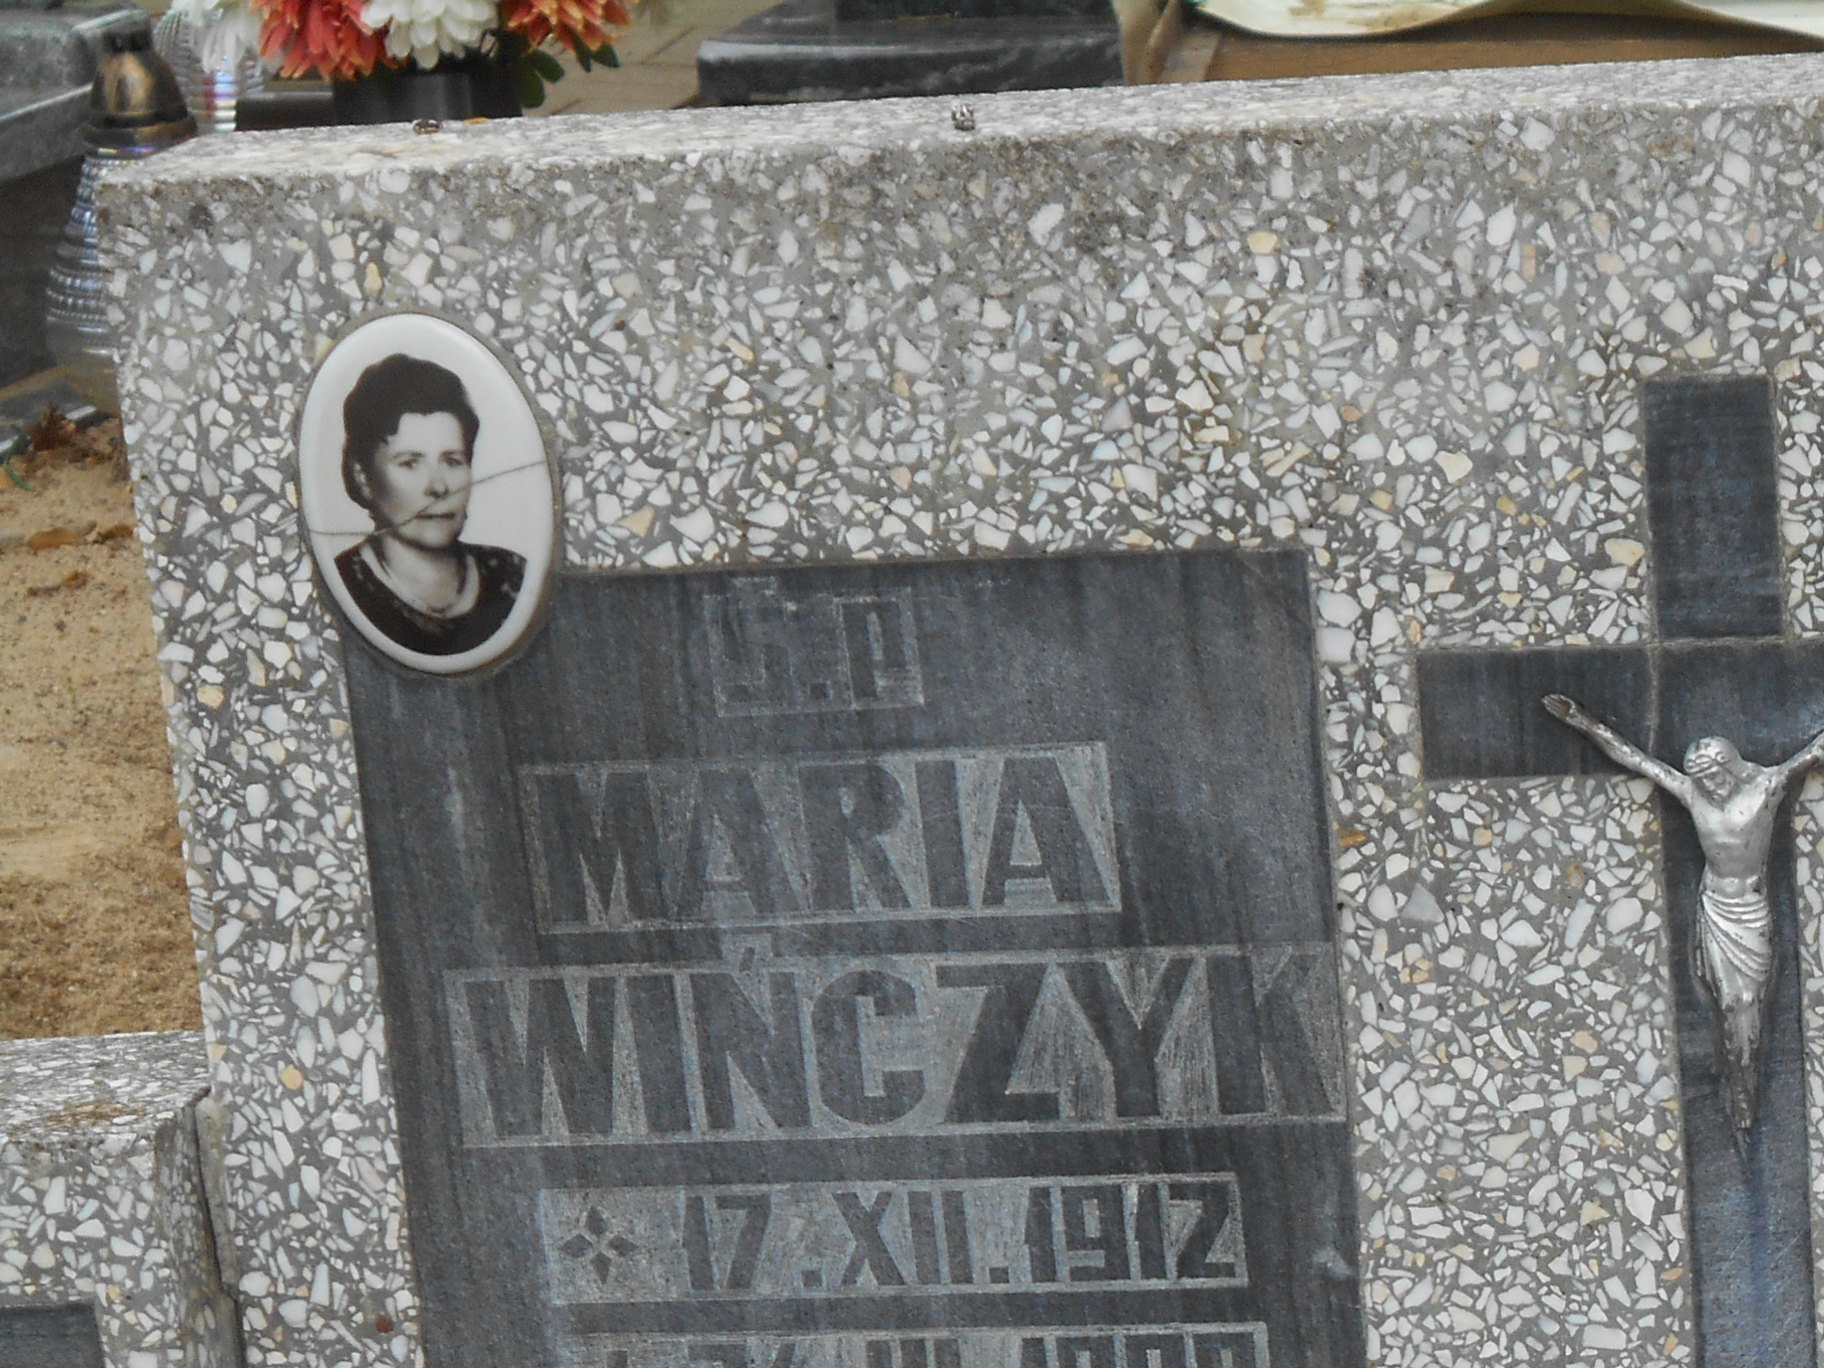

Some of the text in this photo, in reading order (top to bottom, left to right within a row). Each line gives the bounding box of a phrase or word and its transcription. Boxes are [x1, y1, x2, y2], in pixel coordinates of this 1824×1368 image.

[537, 756, 1108, 923] MARIA
[465, 939, 1341, 1137] WIŃCZYK
[681, 1184, 1238, 1290] 17.XII.1912
